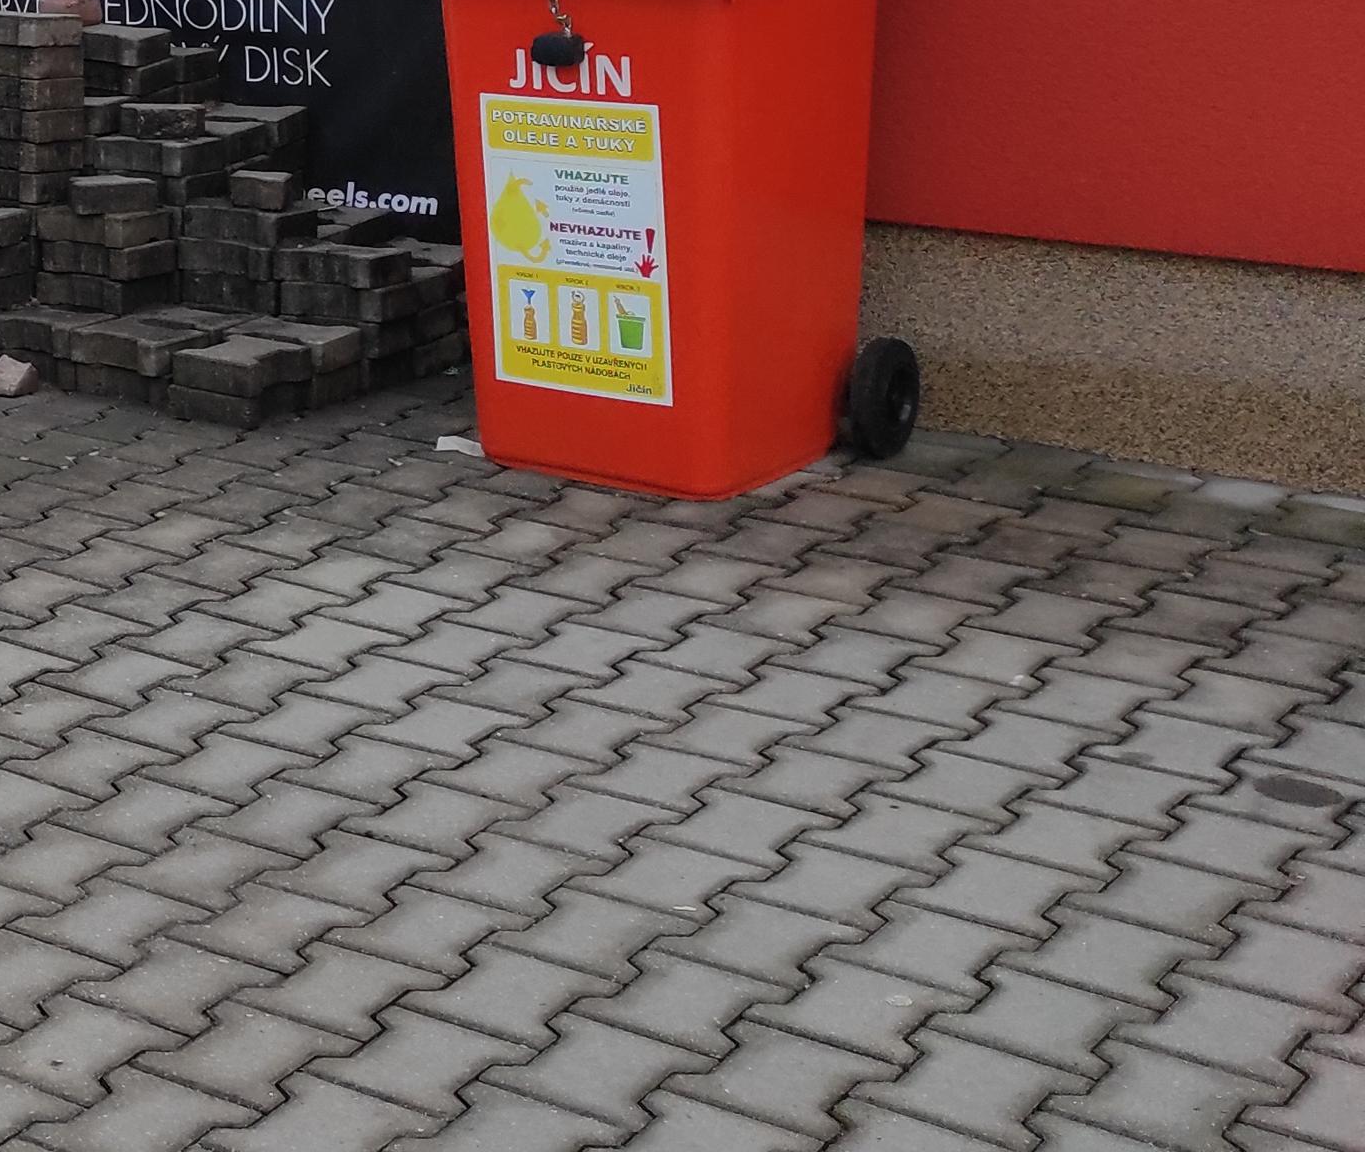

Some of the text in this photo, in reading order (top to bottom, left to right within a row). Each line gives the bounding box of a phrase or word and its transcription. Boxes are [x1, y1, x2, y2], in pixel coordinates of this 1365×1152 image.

[244, 46, 332, 88] DISK
[503, 129, 638, 153] OLEJE A TUKY
[554, 169, 630, 186] VHAZUJTE
[549, 221, 642, 241] NEVHAZUJTE
[516, 345, 556, 358] VHAZUJTE
[557, 351, 583, 363] POUZE
[585, 354, 591, 364] V
[532, 358, 583, 373] PLASTOVÝCH
[626, 382, 653, 396] Jičín
